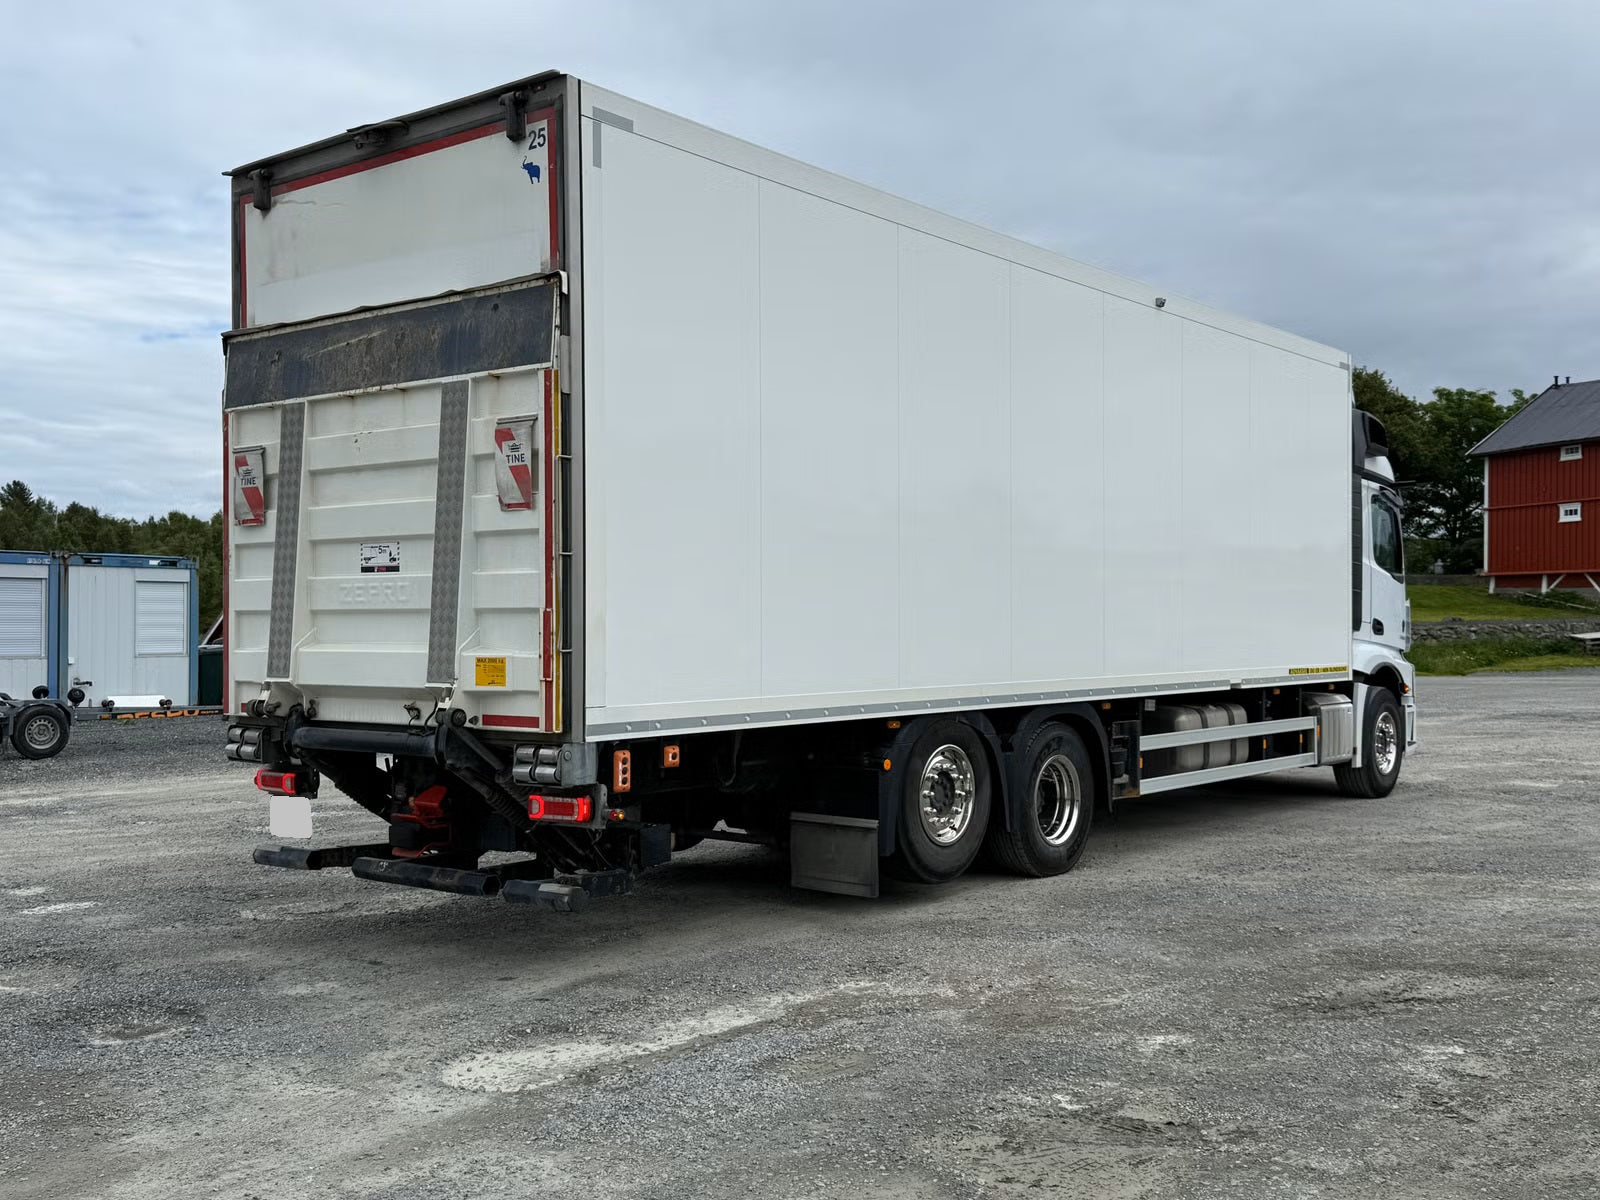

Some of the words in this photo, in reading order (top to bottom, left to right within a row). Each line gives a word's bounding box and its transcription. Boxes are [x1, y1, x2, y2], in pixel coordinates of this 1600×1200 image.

[528, 127, 546, 150] 25
[506, 453, 525, 463] TINE
[240, 477, 256, 486] TINE
